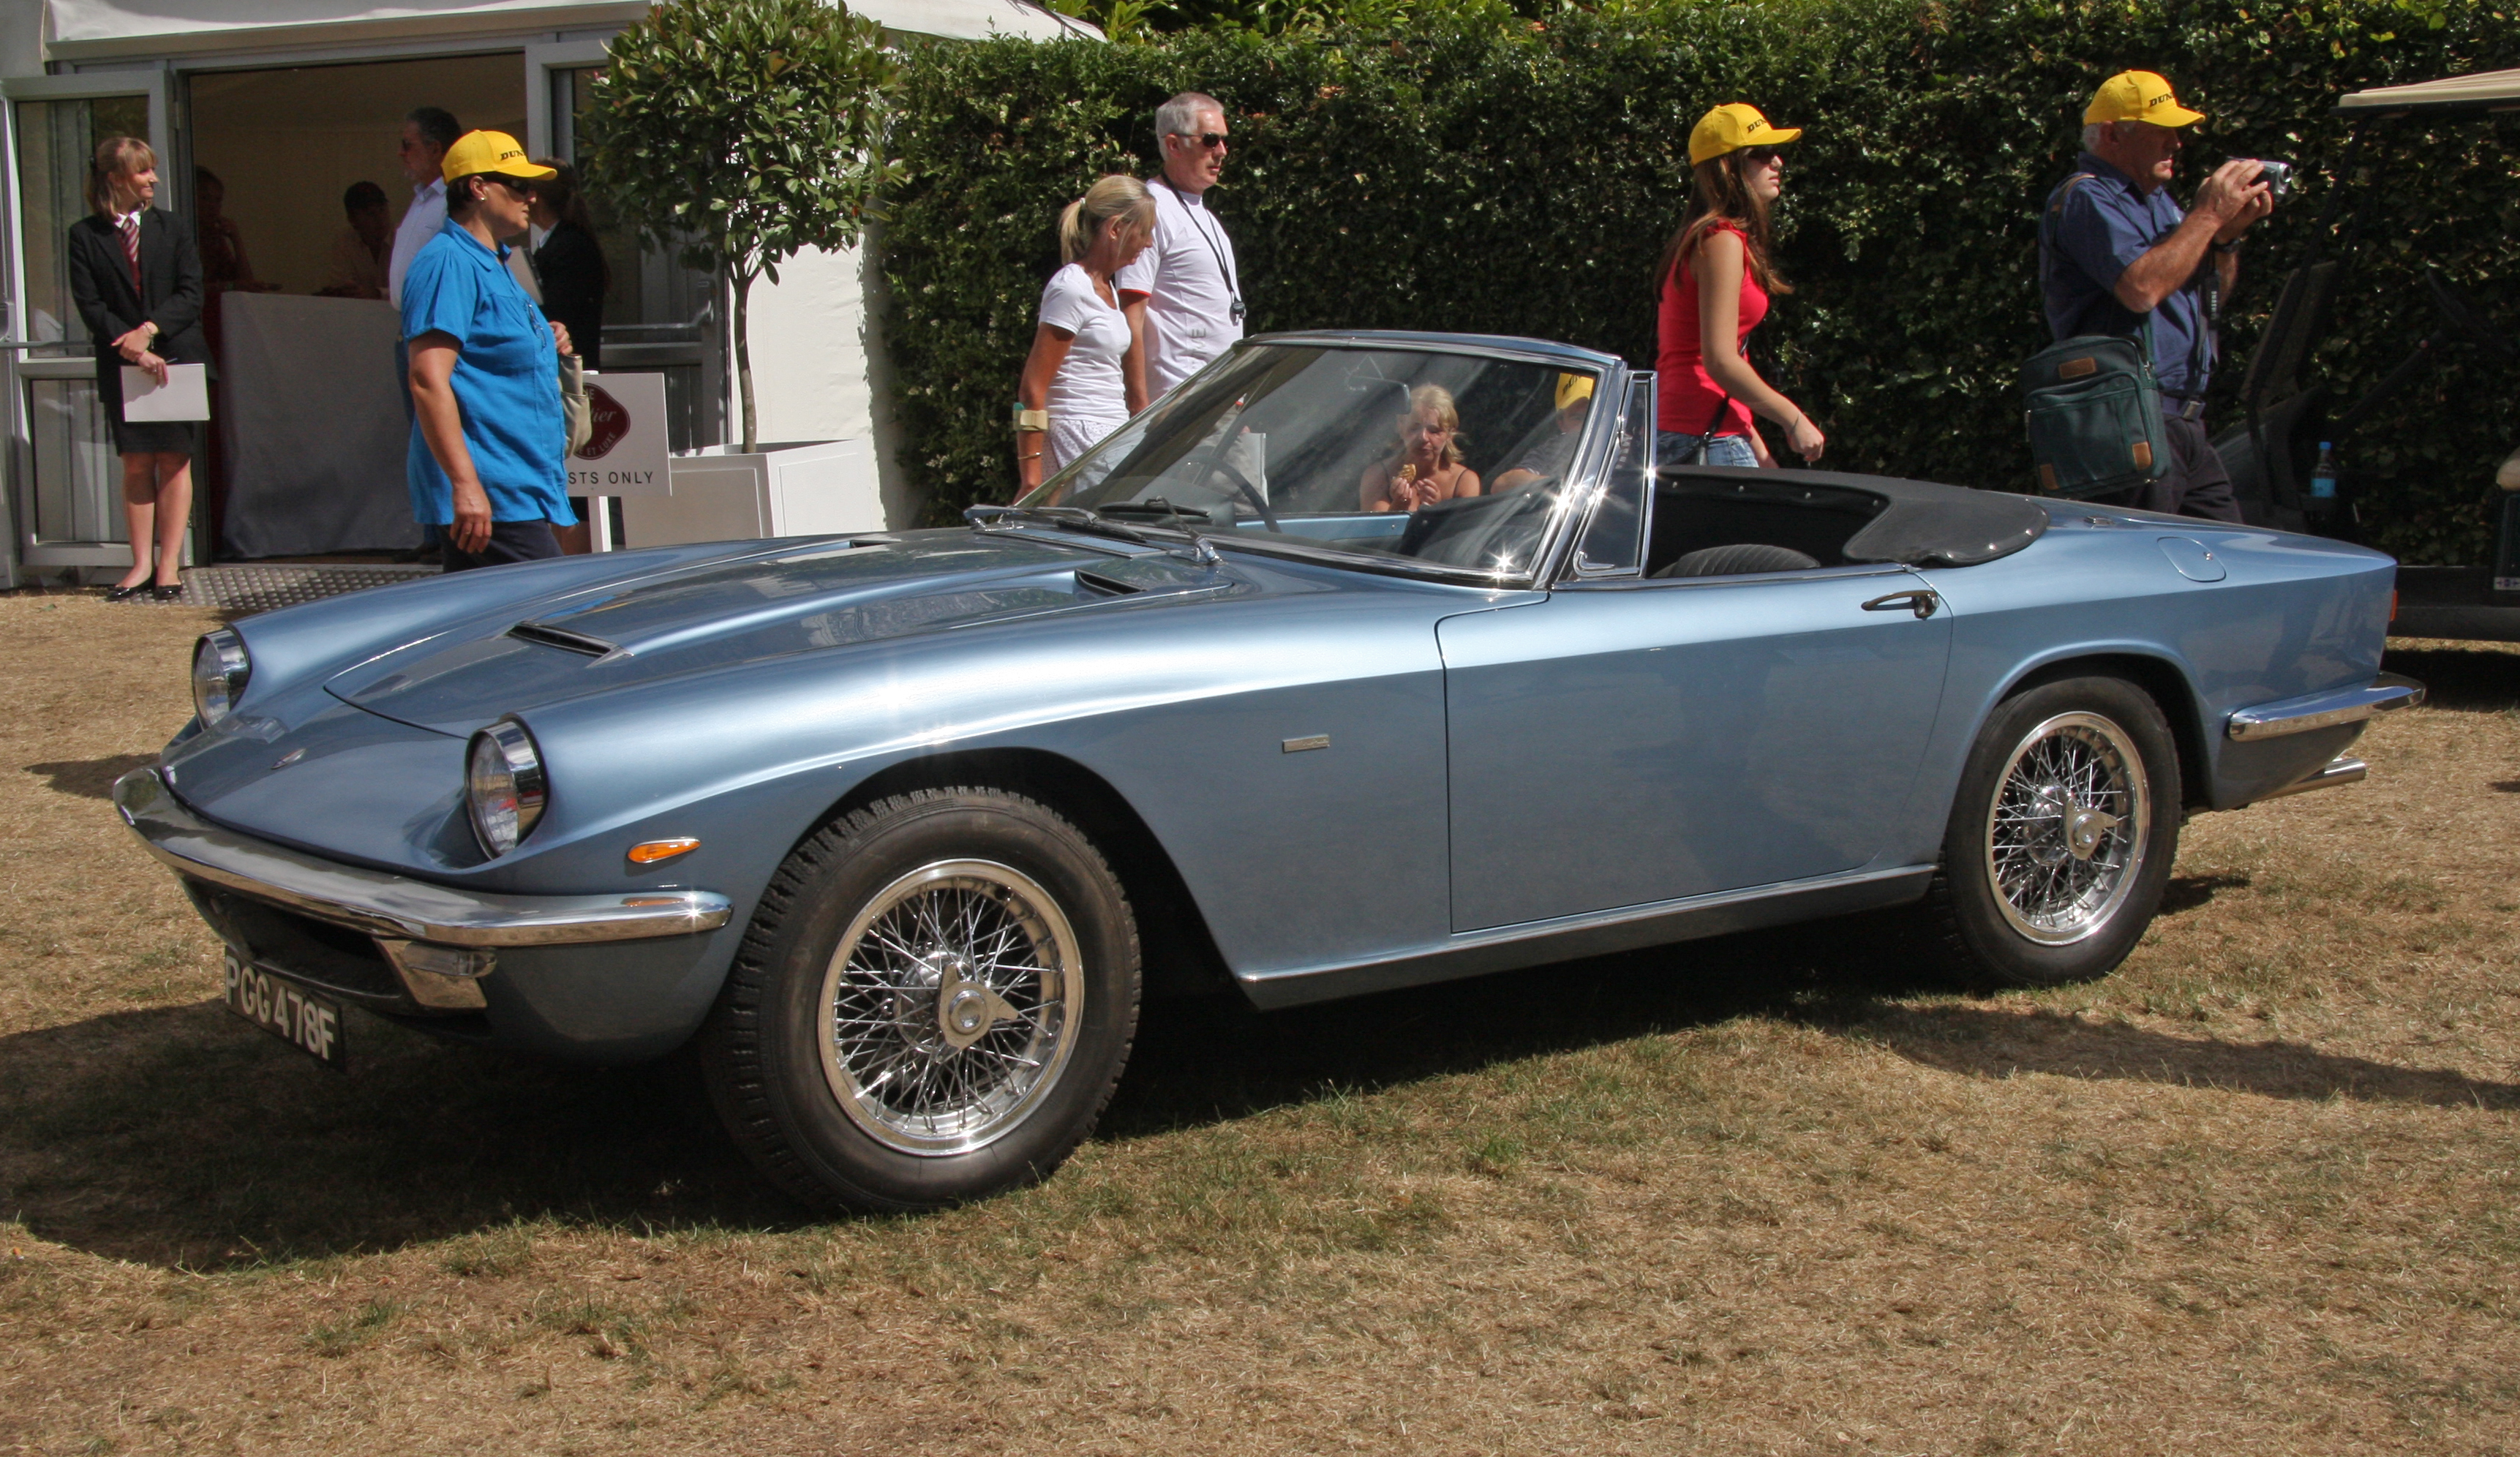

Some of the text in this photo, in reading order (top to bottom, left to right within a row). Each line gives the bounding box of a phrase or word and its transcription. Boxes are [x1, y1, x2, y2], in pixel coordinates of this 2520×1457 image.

[587, 447, 596, 456] ET
[609, 471, 653, 484] ONLY
[225, 955, 335, 1061] PGG 478F
